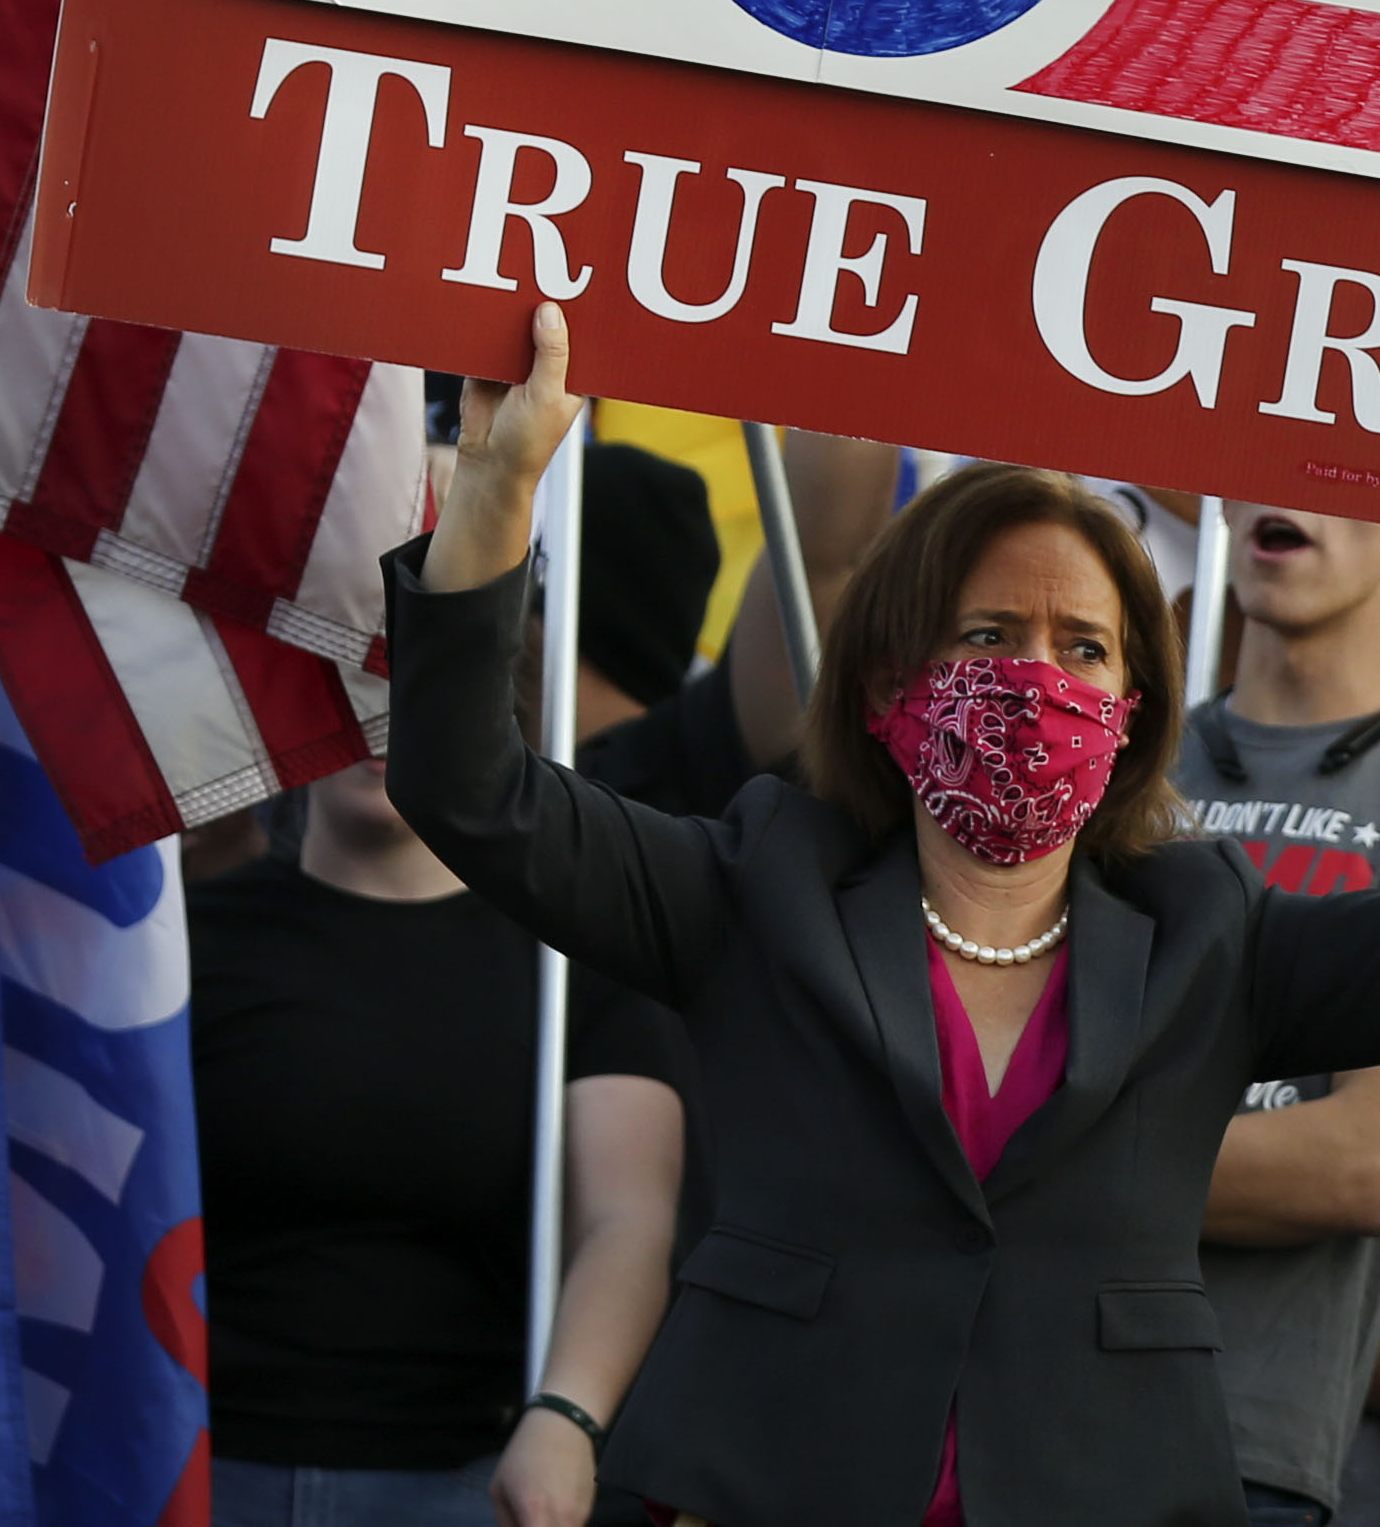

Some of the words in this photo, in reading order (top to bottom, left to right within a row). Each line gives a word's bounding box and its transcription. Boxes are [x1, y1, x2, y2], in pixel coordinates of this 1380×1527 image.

[249, 37, 929, 356] TRUE
[1341, 468, 1362, 483] for
[1202, 799, 1291, 835] DON'T
[1281, 802, 1352, 843] LIKE
